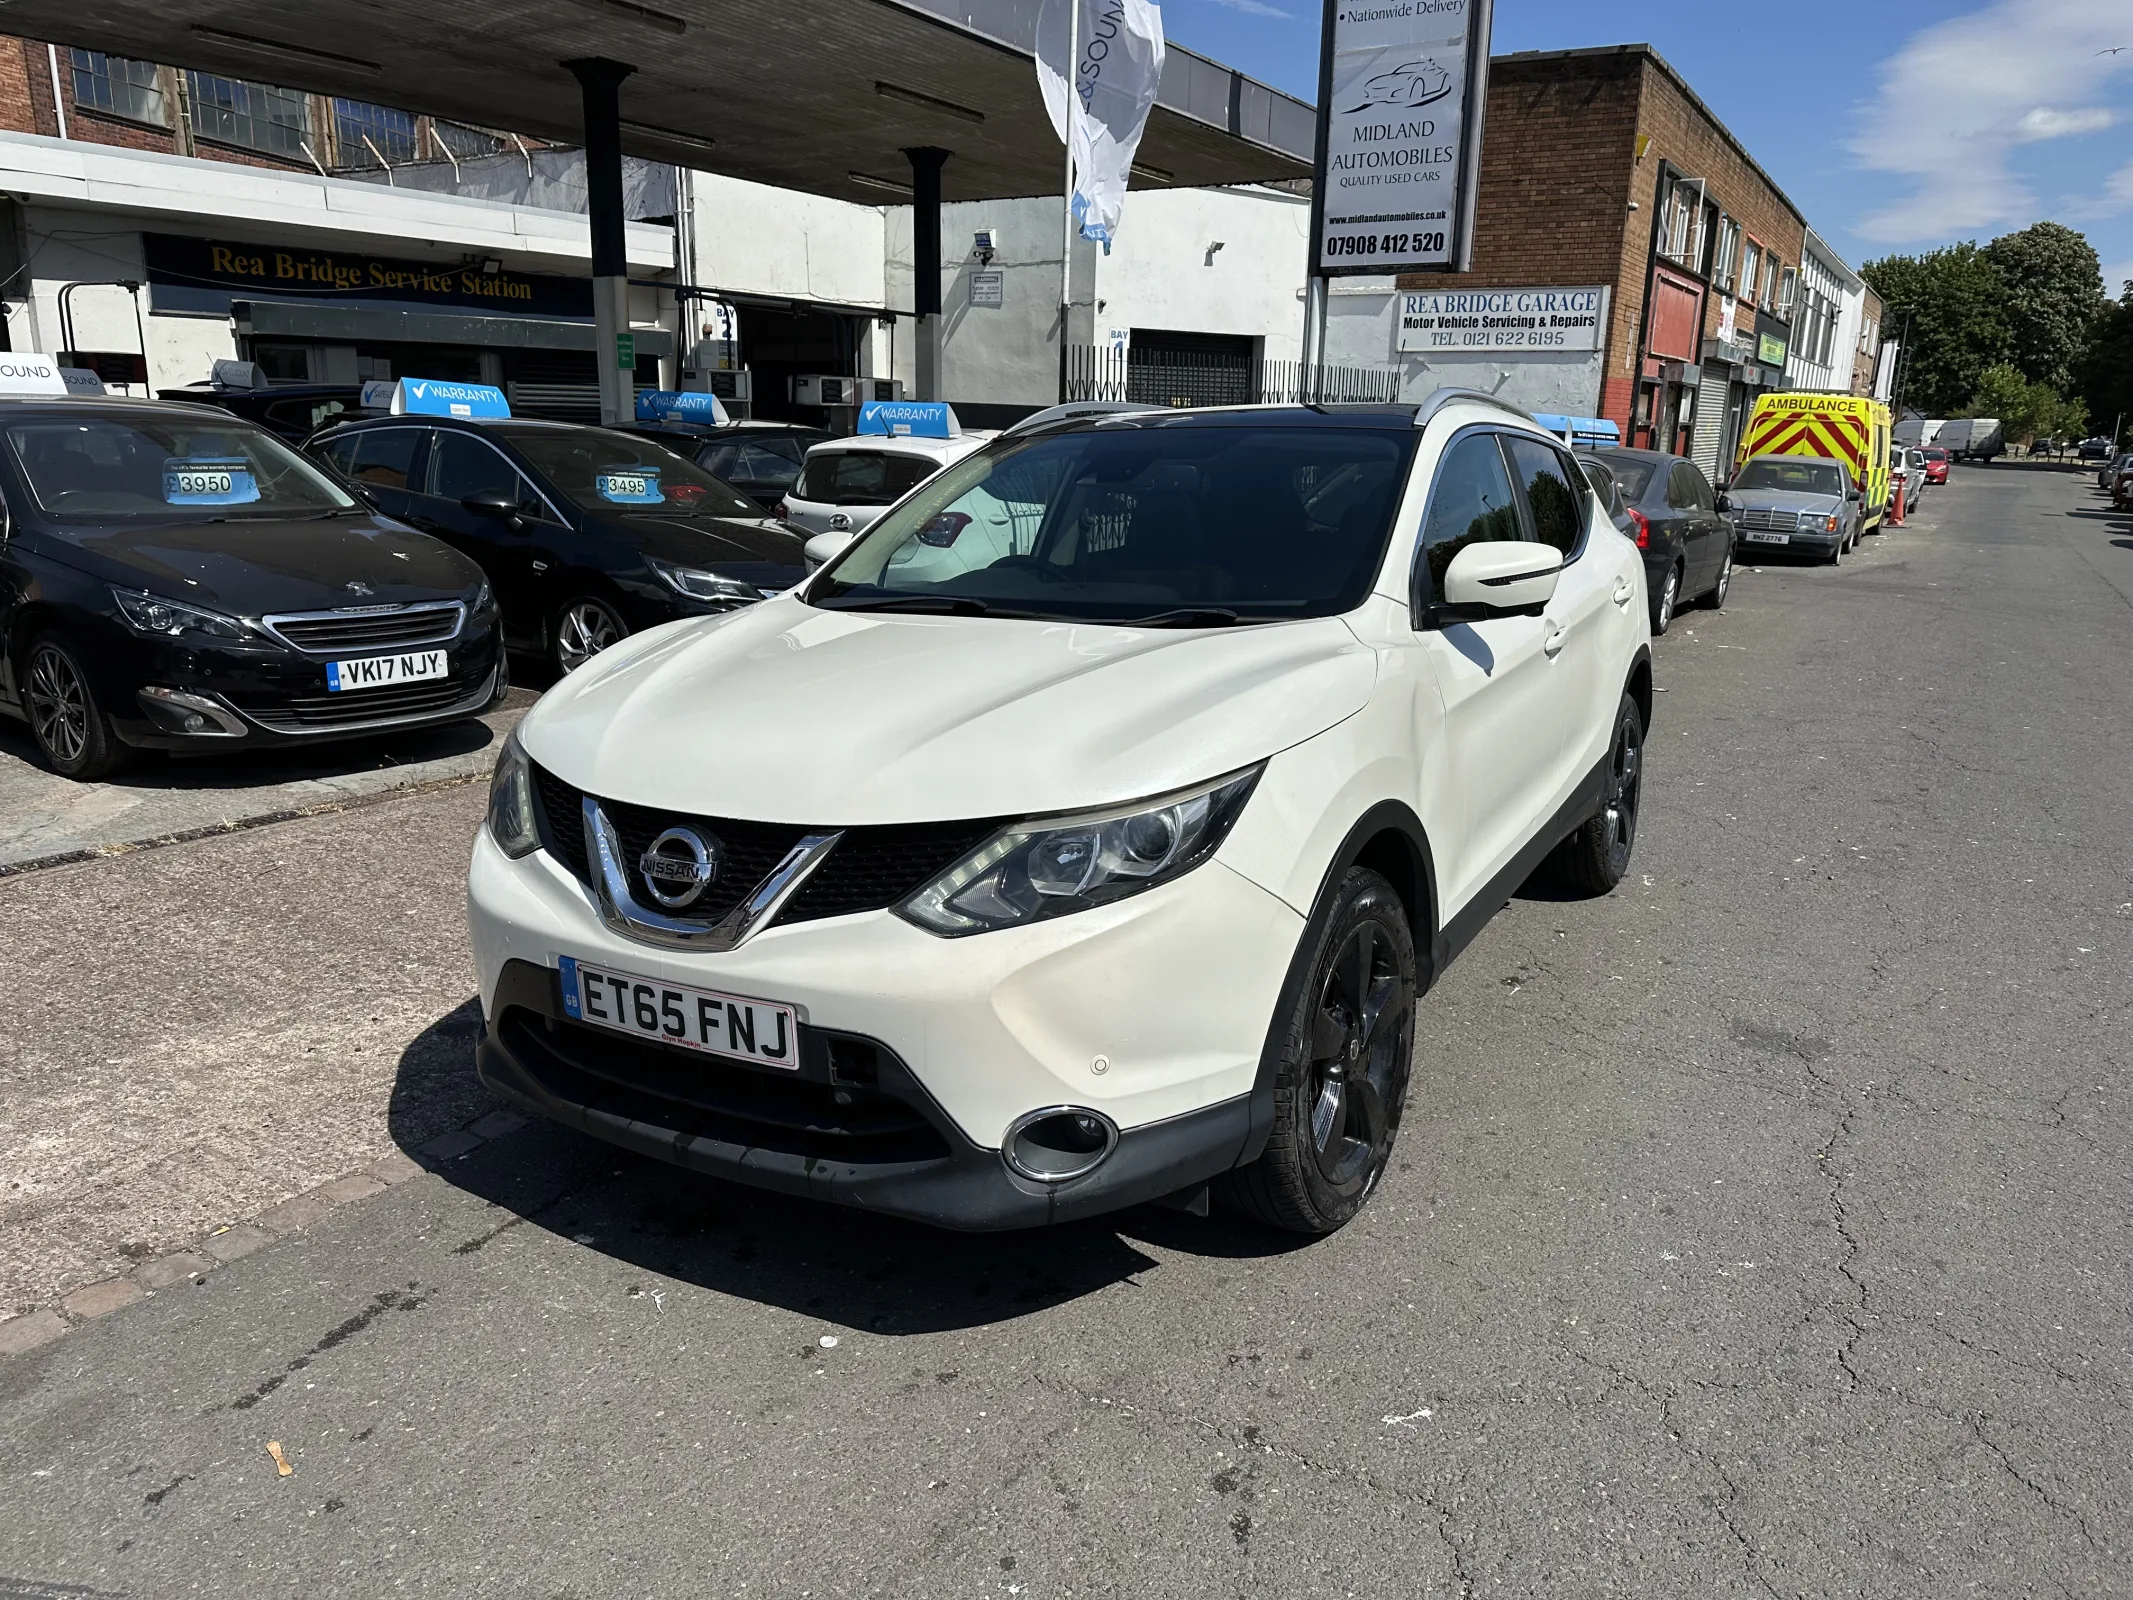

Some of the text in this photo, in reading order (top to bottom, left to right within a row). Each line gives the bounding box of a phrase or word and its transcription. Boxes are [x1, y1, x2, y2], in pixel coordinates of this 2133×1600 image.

[1347, 0, 1466, 23] Nationwide Delivery
[1353, 120, 1435, 143] MIDLAND
[1331, 146, 1453, 170] AUTOMOBILES
[1340, 170, 1441, 188] QUALITY USED CARS
[1329, 210, 1446, 225] www.midlandautomobiles.co.uk
[1327, 232, 1445, 256] 07908 412 520
[211, 246, 532, 300] Rea Bridge Service Station
[1405, 292, 1597, 313] REA BRIDGE GARAGE
[1404, 314, 1595, 329] Motor Vehicle Servicing & Repairs
[1111, 330, 1129, 340] BAY
[1431, 331, 1565, 346] TEL. 0121 622 6195
[428, 384, 499, 403] WARRANTY
[655, 395, 709, 410] WARRANTY
[880, 406, 943, 421] WARRANTY
[1766, 398, 1858, 413] AMBULANCE
[346, 653, 439, 684] VK17 NJY
[330, 679, 339, 687] GB
[641, 858, 700, 879] NISSAN
[565, 993, 578, 1009] GB
[582, 970, 789, 1059] ET65 FNJ
[661, 1033, 702, 1049] Glyn Hopkin
